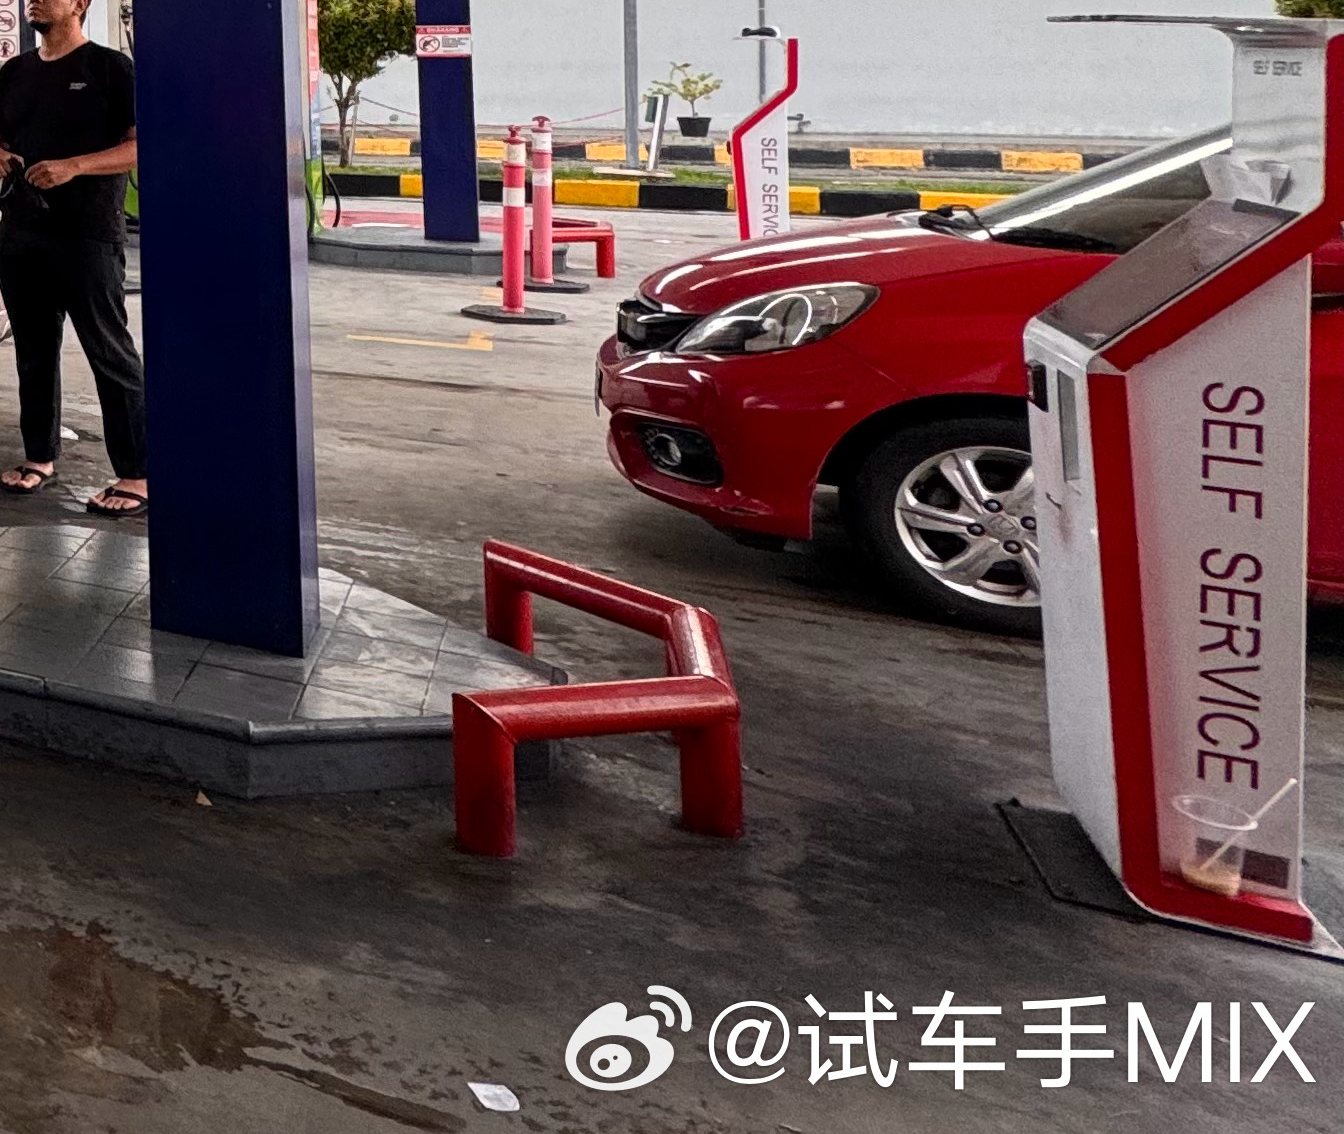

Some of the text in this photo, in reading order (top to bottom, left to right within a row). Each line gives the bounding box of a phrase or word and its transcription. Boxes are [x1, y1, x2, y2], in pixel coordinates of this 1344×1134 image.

[760, 136, 780, 237] SELF SERVIC
[1197, 382, 1266, 791] SELF SERVICE
